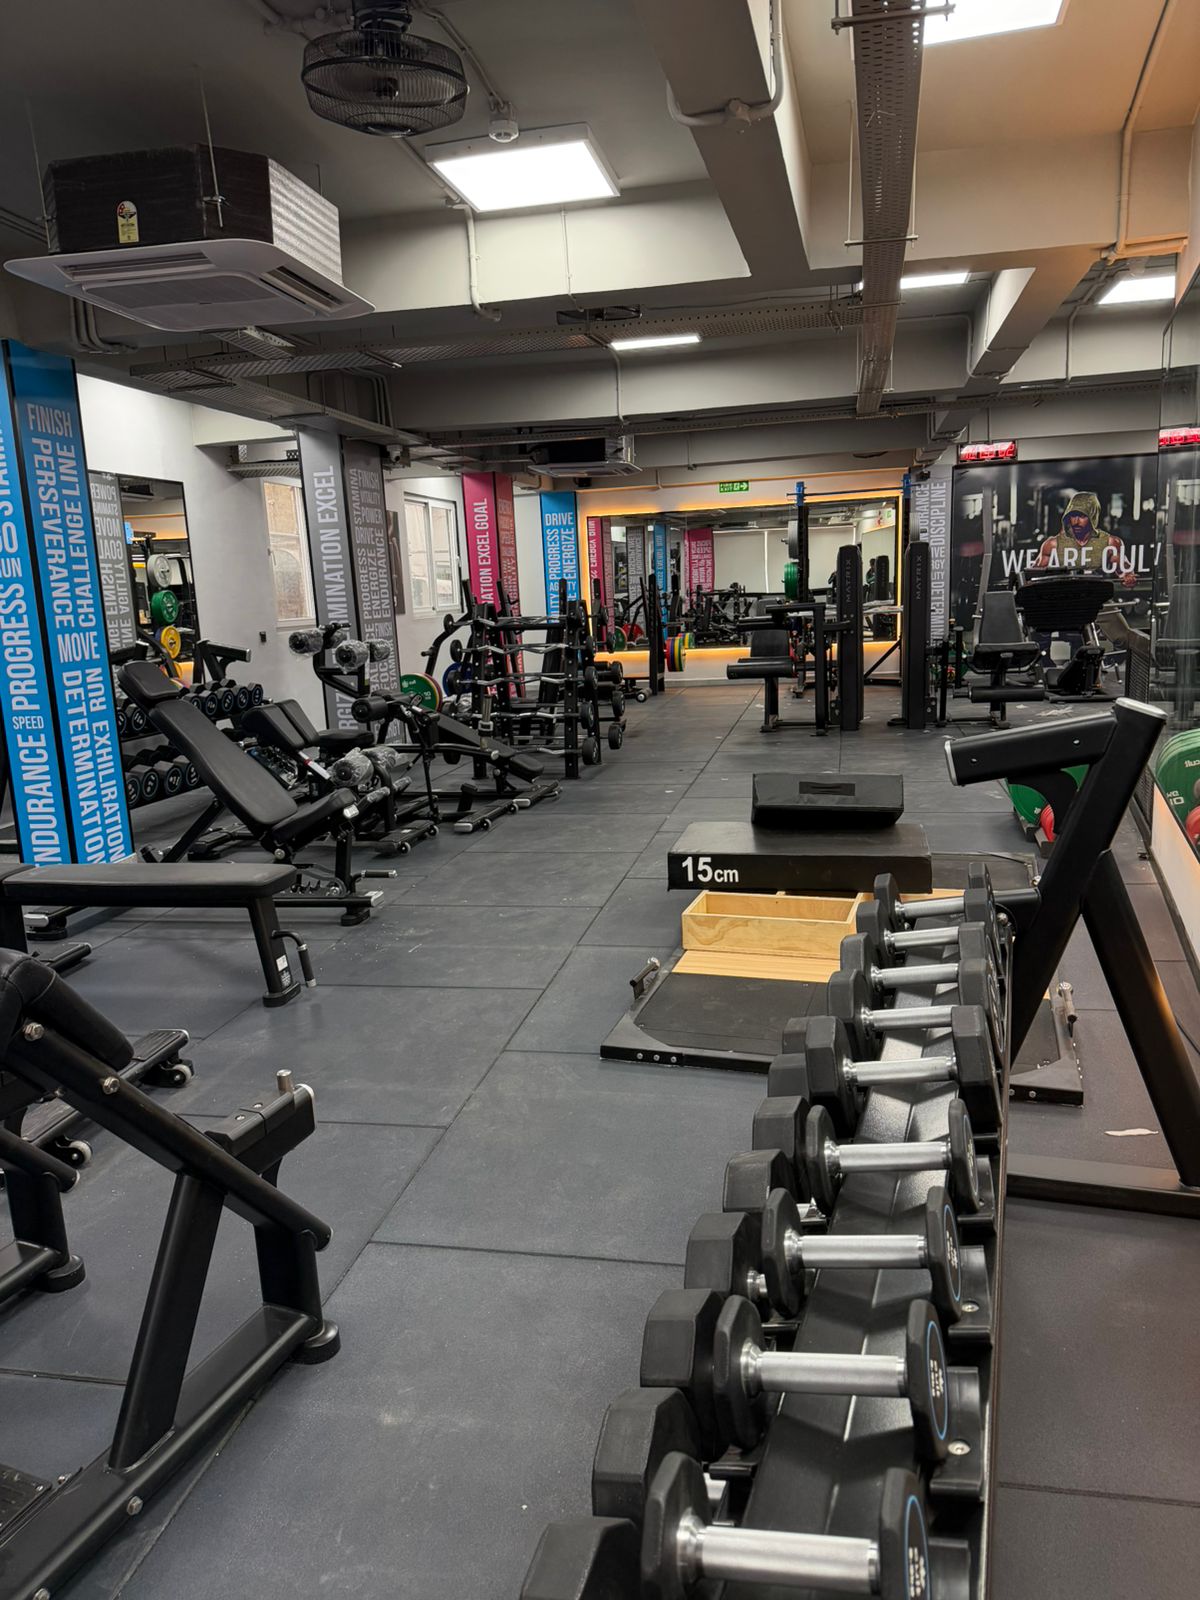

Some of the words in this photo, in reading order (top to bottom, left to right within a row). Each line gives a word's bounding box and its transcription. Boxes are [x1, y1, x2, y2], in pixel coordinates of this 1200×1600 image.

[26, 403, 73, 438] FINISH
[56, 441, 80, 497] LINE
[312, 465, 339, 524] EXCEL
[349, 468, 363, 525] STAMINA
[473, 497, 489, 531] GOAL
[544, 512, 574, 526] DRIVE
[930, 482, 946, 546] DISCIPLINE
[31, 437, 75, 629] PERSEVERANCE
[355, 526, 376, 545] DRIVE
[476, 531, 492, 566] EXCEL
[546, 528, 561, 580] PROGRESS
[560, 527, 577, 580] ENERGIZE
[1048, 547, 1093, 568] ARE
[64, 500, 97, 627] CHALLENGE
[357, 547, 372, 620] PROGRESS
[366, 549, 382, 618] ENERGIZE
[375, 528, 391, 618] ENDURANCE
[0, 583, 41, 711] PROGRESS
[57, 631, 100, 664] MOVE
[85, 667, 106, 714] RUN
[12, 715, 44, 730] SPEED
[62, 670, 107, 864] DETERMINATION
[17, 733, 62, 866] NDURANCE
[682, 856, 739, 882] 15cm
